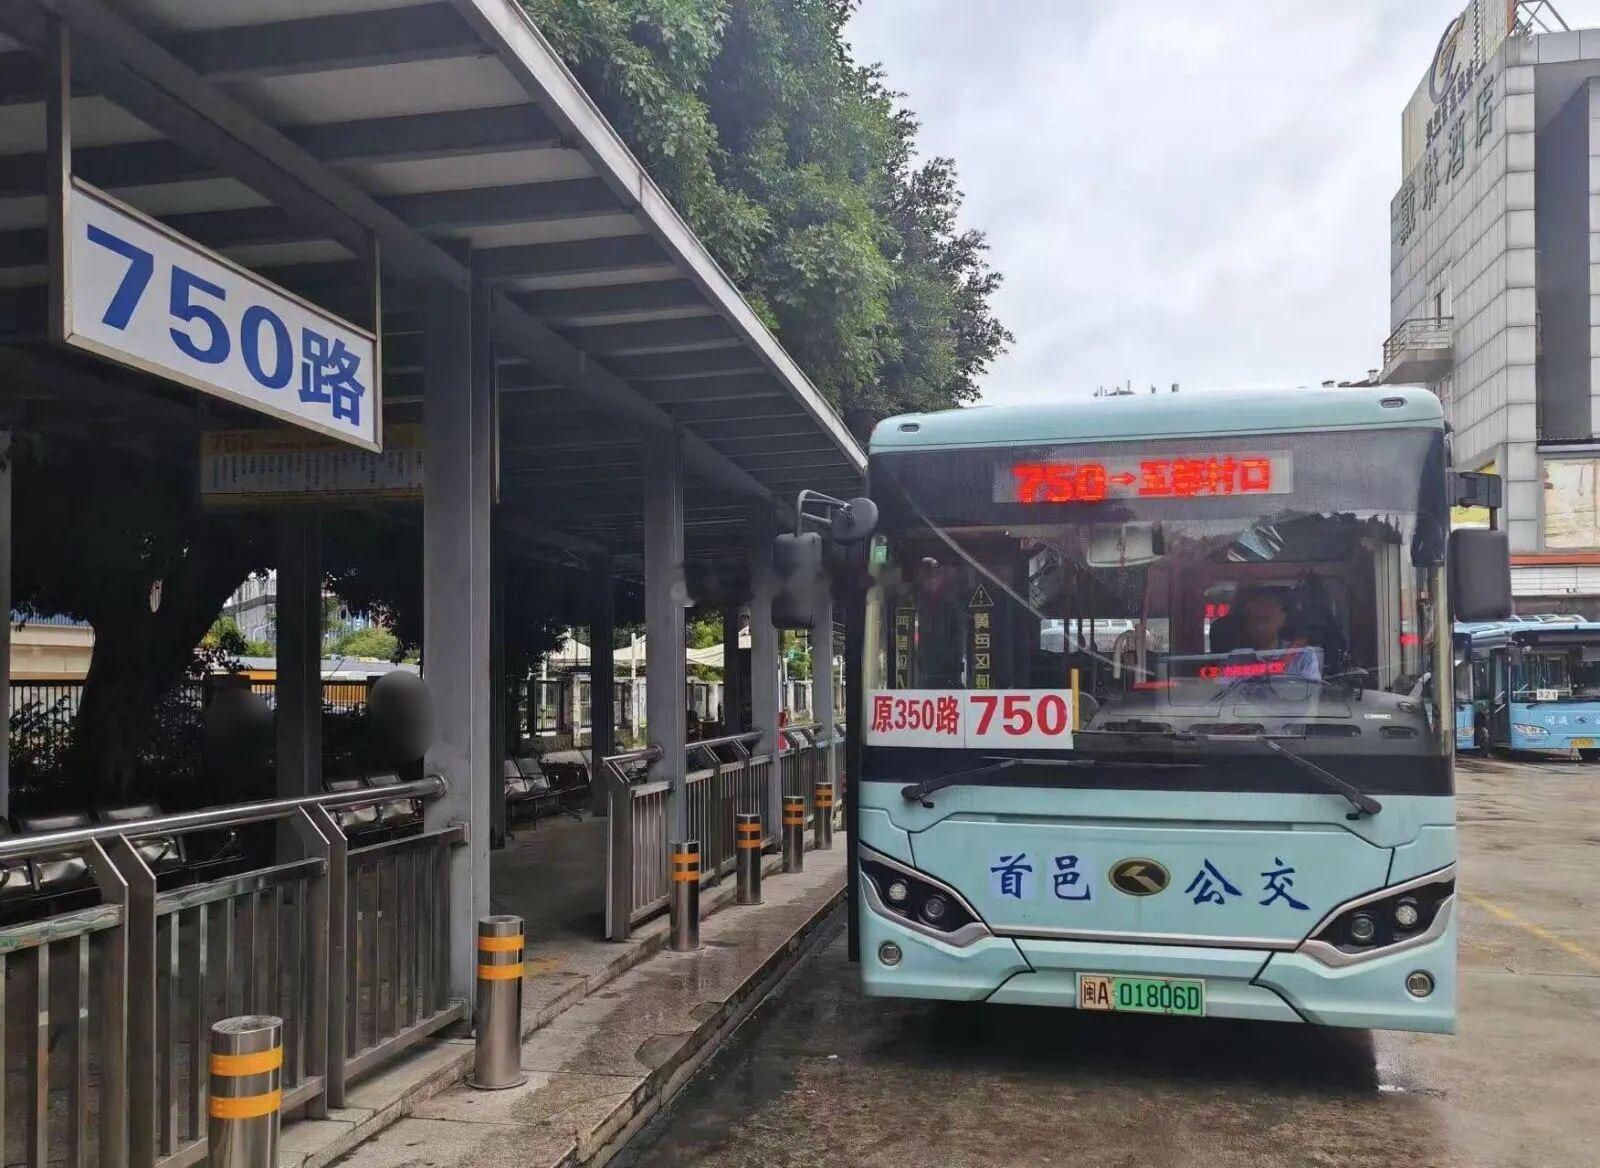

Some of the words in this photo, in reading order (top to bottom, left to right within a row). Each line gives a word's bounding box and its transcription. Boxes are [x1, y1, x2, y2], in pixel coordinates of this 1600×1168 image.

[87, 223, 366, 427] 750路
[1012, 463, 1107, 503] 750
[872, 695, 960, 736] 原350路
[970, 694, 1068, 736] 750
[1537, 690, 1557, 699] 321
[990, 852, 1091, 901] 首邑
[1184, 857, 1310, 911] 公交
[1083, 979, 1109, 1005] 闽A
[1119, 983, 1200, 1010] 01806D
